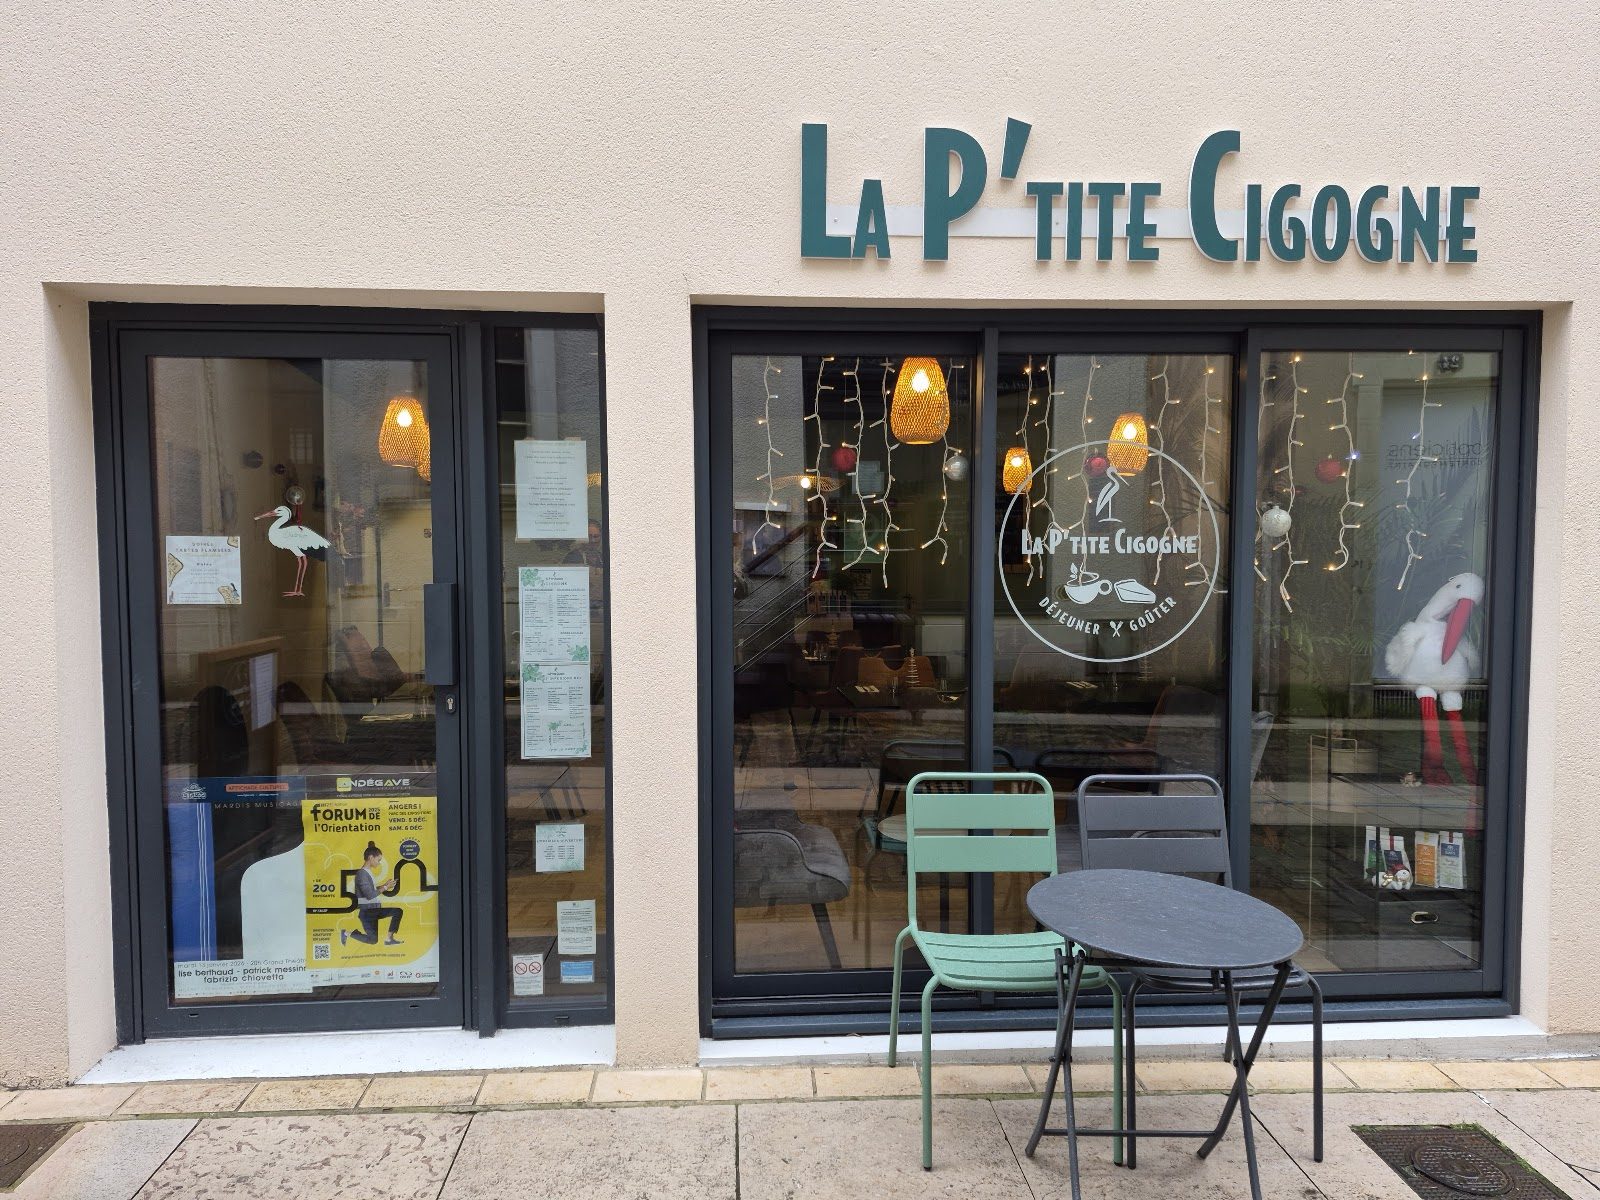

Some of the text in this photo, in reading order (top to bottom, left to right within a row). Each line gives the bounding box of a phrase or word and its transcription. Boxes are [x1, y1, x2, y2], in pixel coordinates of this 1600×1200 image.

[1188, 130, 1481, 264] CIGOGNE
[1115, 528, 1199, 554] CIGOGNE
[1038, 596, 1177, 635] DÉJEUNER GOÛTER
[369, 812, 380, 820] DE
[313, 884, 336, 892] 200
[195, 968, 234, 976] berthaud
[243, 967, 272, 975] patrick
[204, 975, 238, 983] fabrizio
